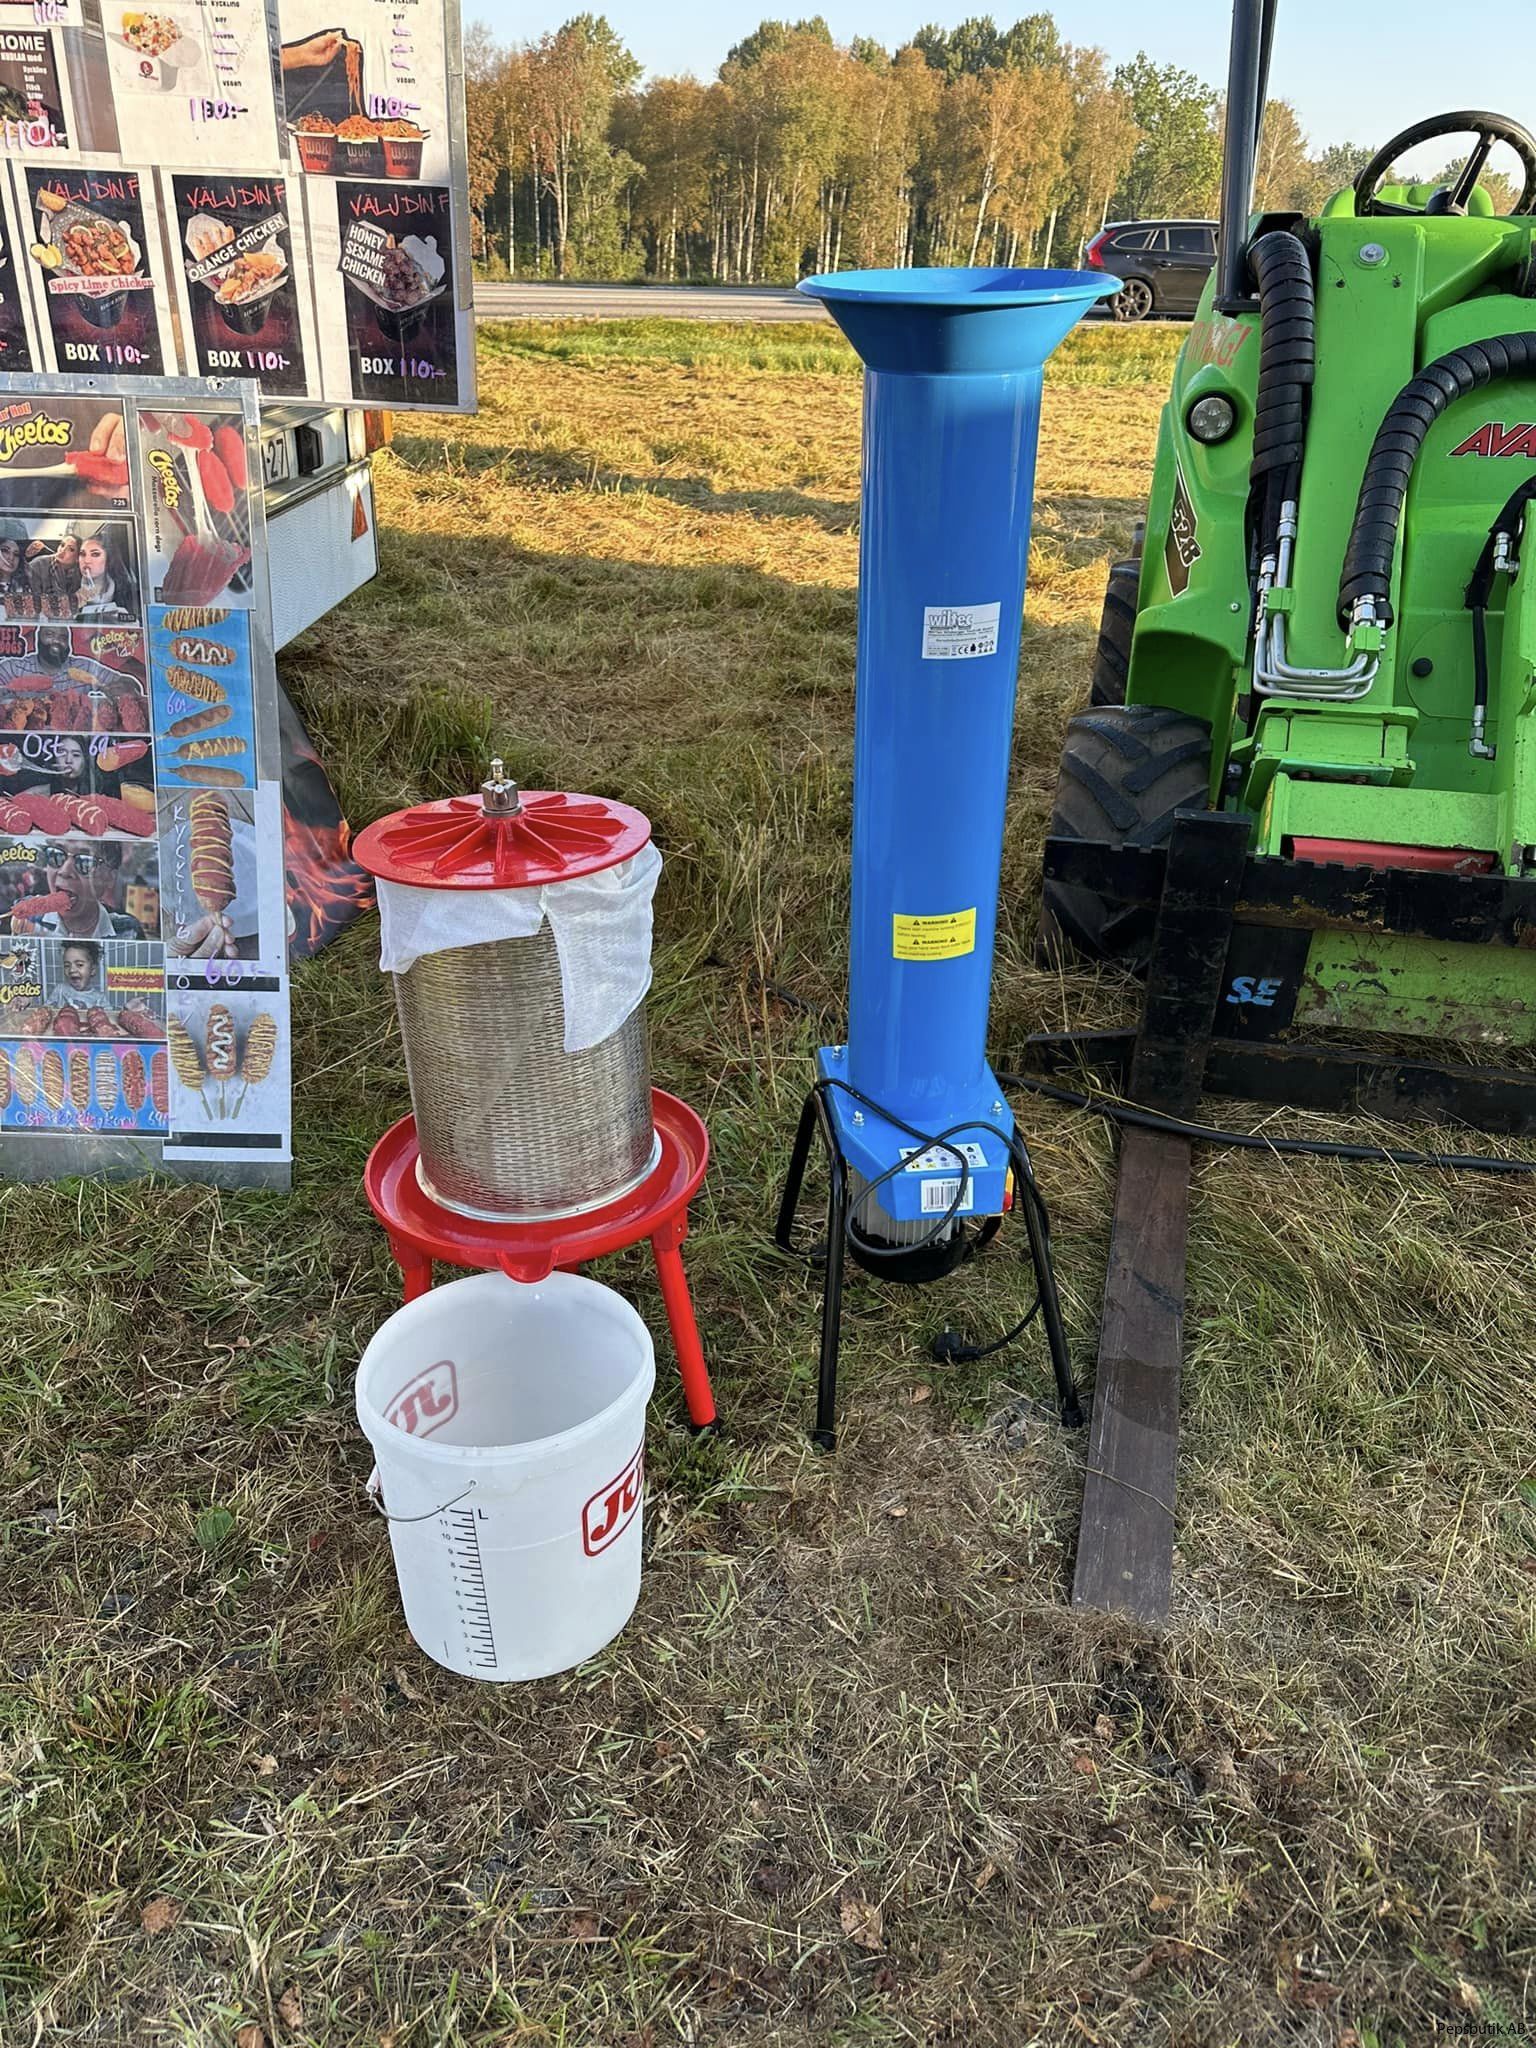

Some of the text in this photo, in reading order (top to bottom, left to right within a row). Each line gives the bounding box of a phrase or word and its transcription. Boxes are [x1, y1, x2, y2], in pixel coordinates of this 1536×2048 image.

[93, 179, 125, 199] DIN
[187, 185, 236, 209] VÄLJ
[238, 184, 270, 206] DIN
[350, 193, 399, 216] VÄLJ
[401, 193, 434, 214] DIN
[188, 216, 284, 280] ORANGE CHICKEN
[349, 225, 384, 250] HONEY
[345, 240, 386, 269] SESAME
[341, 256, 386, 287] CHICKEN
[51, 277, 154, 292] Spicy Lime Chicken
[65, 343, 100, 361] BOX
[208, 350, 242, 367] BOX
[361, 356, 394, 375] BOX
[0, 413, 72, 461] Cheetos
[148, 449, 182, 511] Cheetos
[928, 610, 973, 628] wiltec
[91, 631, 125, 653] Cheetos
[23, 733, 66, 761] Ost
[0, 982, 42, 1003] Cheetos
[1226, 976, 1283, 1007] SE
[440, 1519, 448, 1527] 11
[478, 1508, 489, 1520] L
